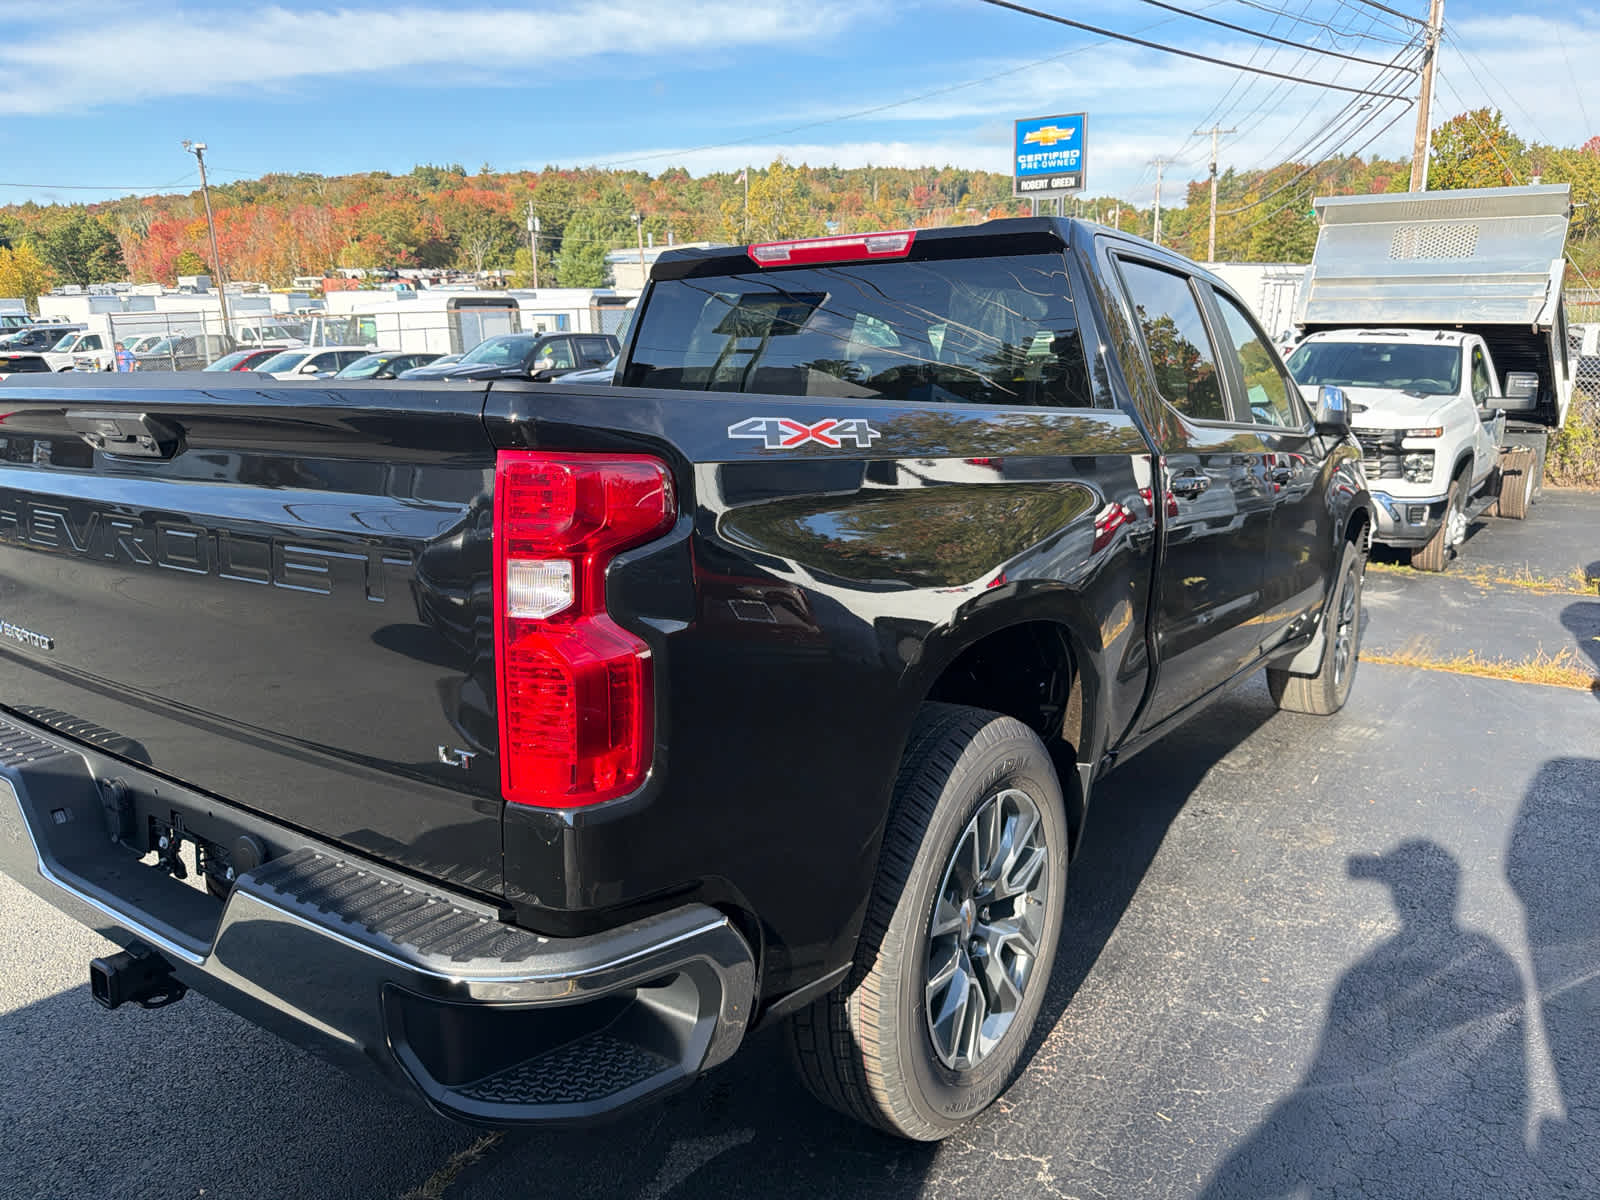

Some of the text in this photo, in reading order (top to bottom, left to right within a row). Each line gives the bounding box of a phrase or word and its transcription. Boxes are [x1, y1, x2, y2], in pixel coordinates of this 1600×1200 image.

[1017, 149, 1080, 163] CERTIFIED
[1021, 158, 1076, 170] PRE-OWNED
[1021, 177, 1075, 190] ROBERT GREEN
[438, 745, 478, 769] LT
